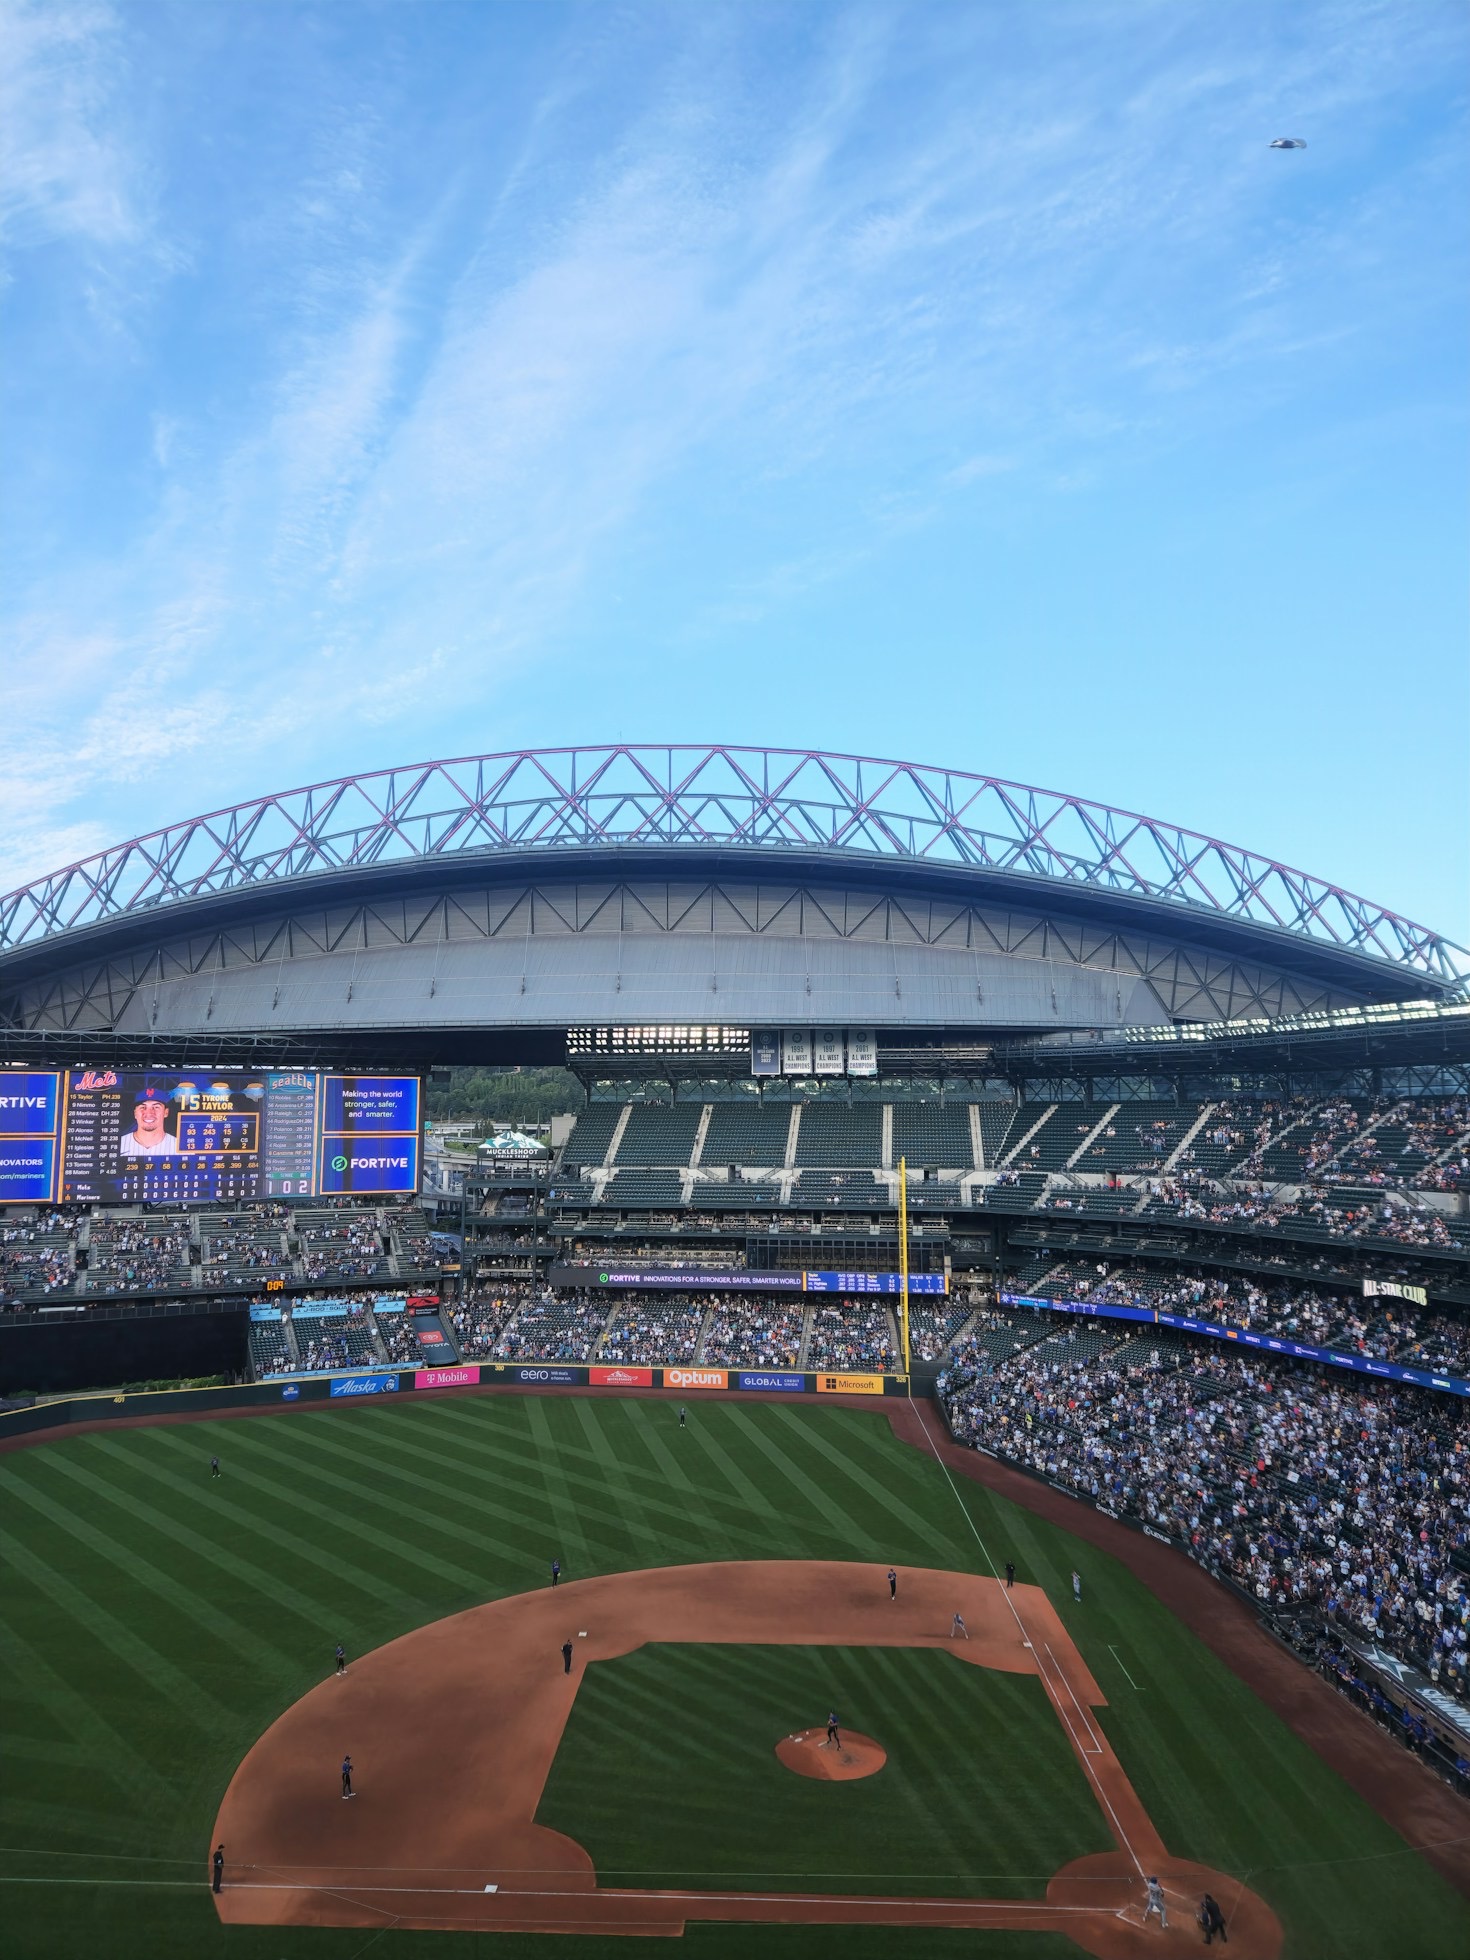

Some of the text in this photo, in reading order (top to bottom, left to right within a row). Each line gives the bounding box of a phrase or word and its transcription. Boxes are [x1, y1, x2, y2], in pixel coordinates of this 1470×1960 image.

[75, 1071, 117, 1090] Mets
[272, 1073, 312, 1090] seattle
[181, 1095, 200, 1110] 15
[351, 1158, 408, 1168] FORTIVE
[283, 1181, 291, 1193] 0
[299, 1181, 307, 1193] 2
[267, 1281, 283, 1290] 0:09
[1364, 1280, 1427, 1306] ALL-STAR CLUB
[427, 1372, 468, 1383] T Mobile
[521, 1370, 548, 1380] eero
[670, 1370, 721, 1387] Optum
[334, 1380, 376, 1394] Alaska
[744, 1378, 782, 1386] GLOBAL
